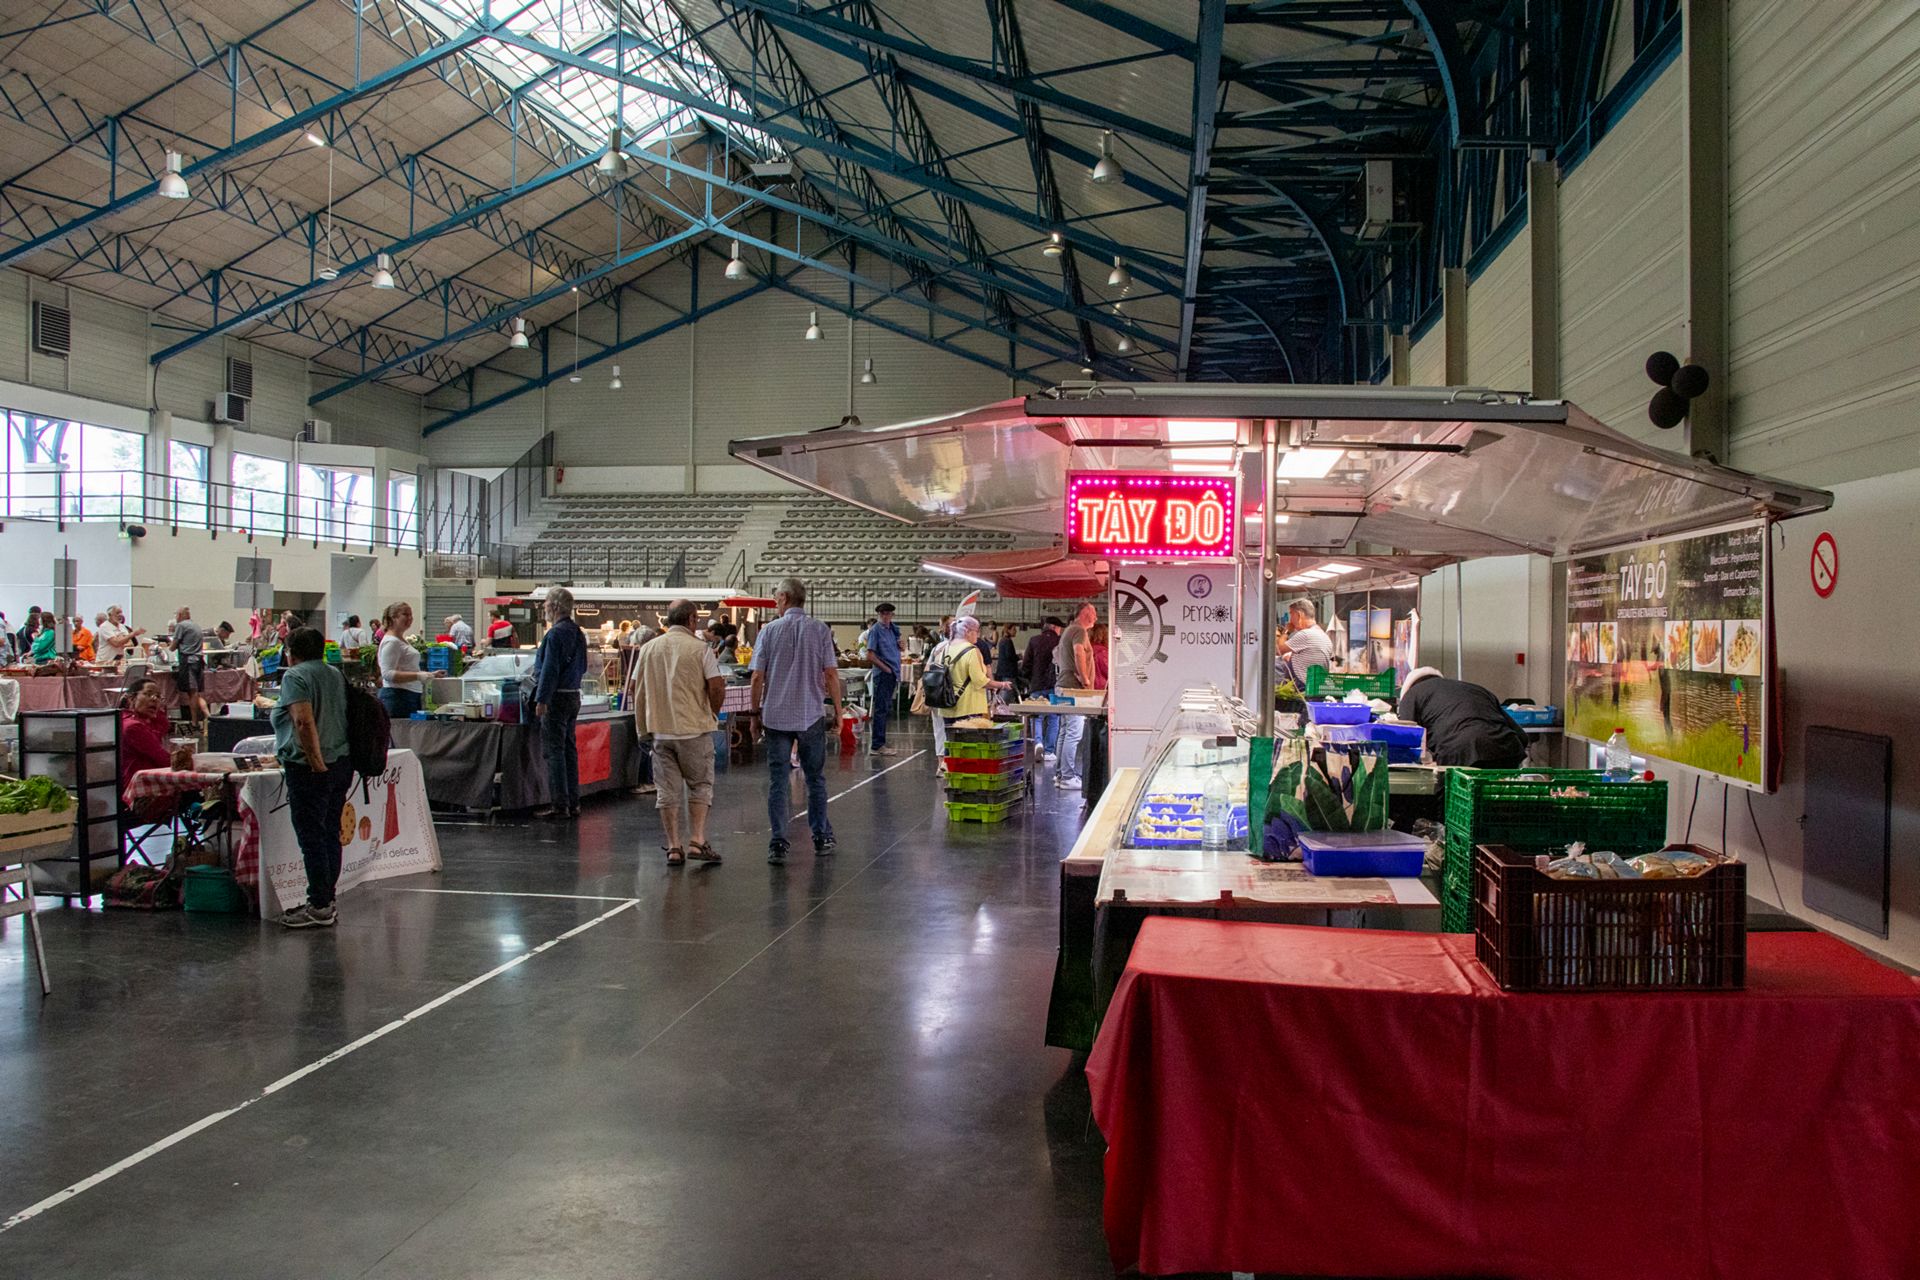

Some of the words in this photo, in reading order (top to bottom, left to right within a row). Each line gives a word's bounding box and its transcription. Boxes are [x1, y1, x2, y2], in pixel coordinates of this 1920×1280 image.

[1164, 490, 1225, 545] ĐÔ
[1620, 555, 1643, 601] TÂY
[1644, 549, 1667, 599] ĐÔ
[1180, 631, 1255, 645] POISSONNIE
